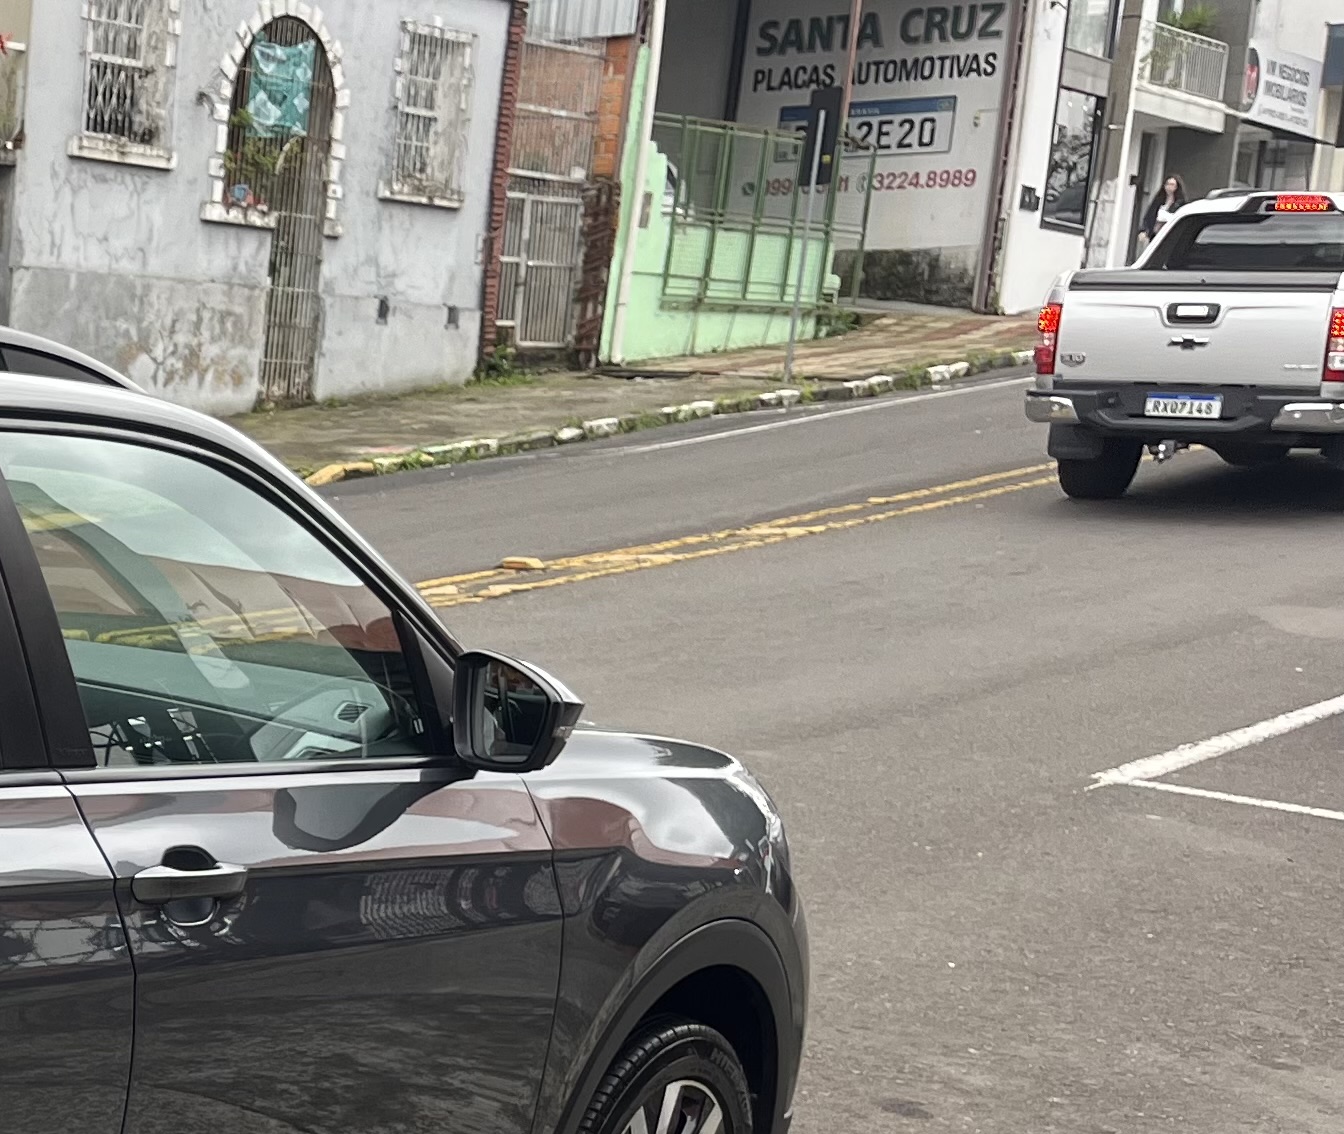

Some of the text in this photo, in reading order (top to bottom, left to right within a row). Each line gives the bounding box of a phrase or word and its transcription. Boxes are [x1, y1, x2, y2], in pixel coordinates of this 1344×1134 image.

[756, 2, 1005, 56] SANTA CRUZ
[753, 63, 836, 93] PLACAS
